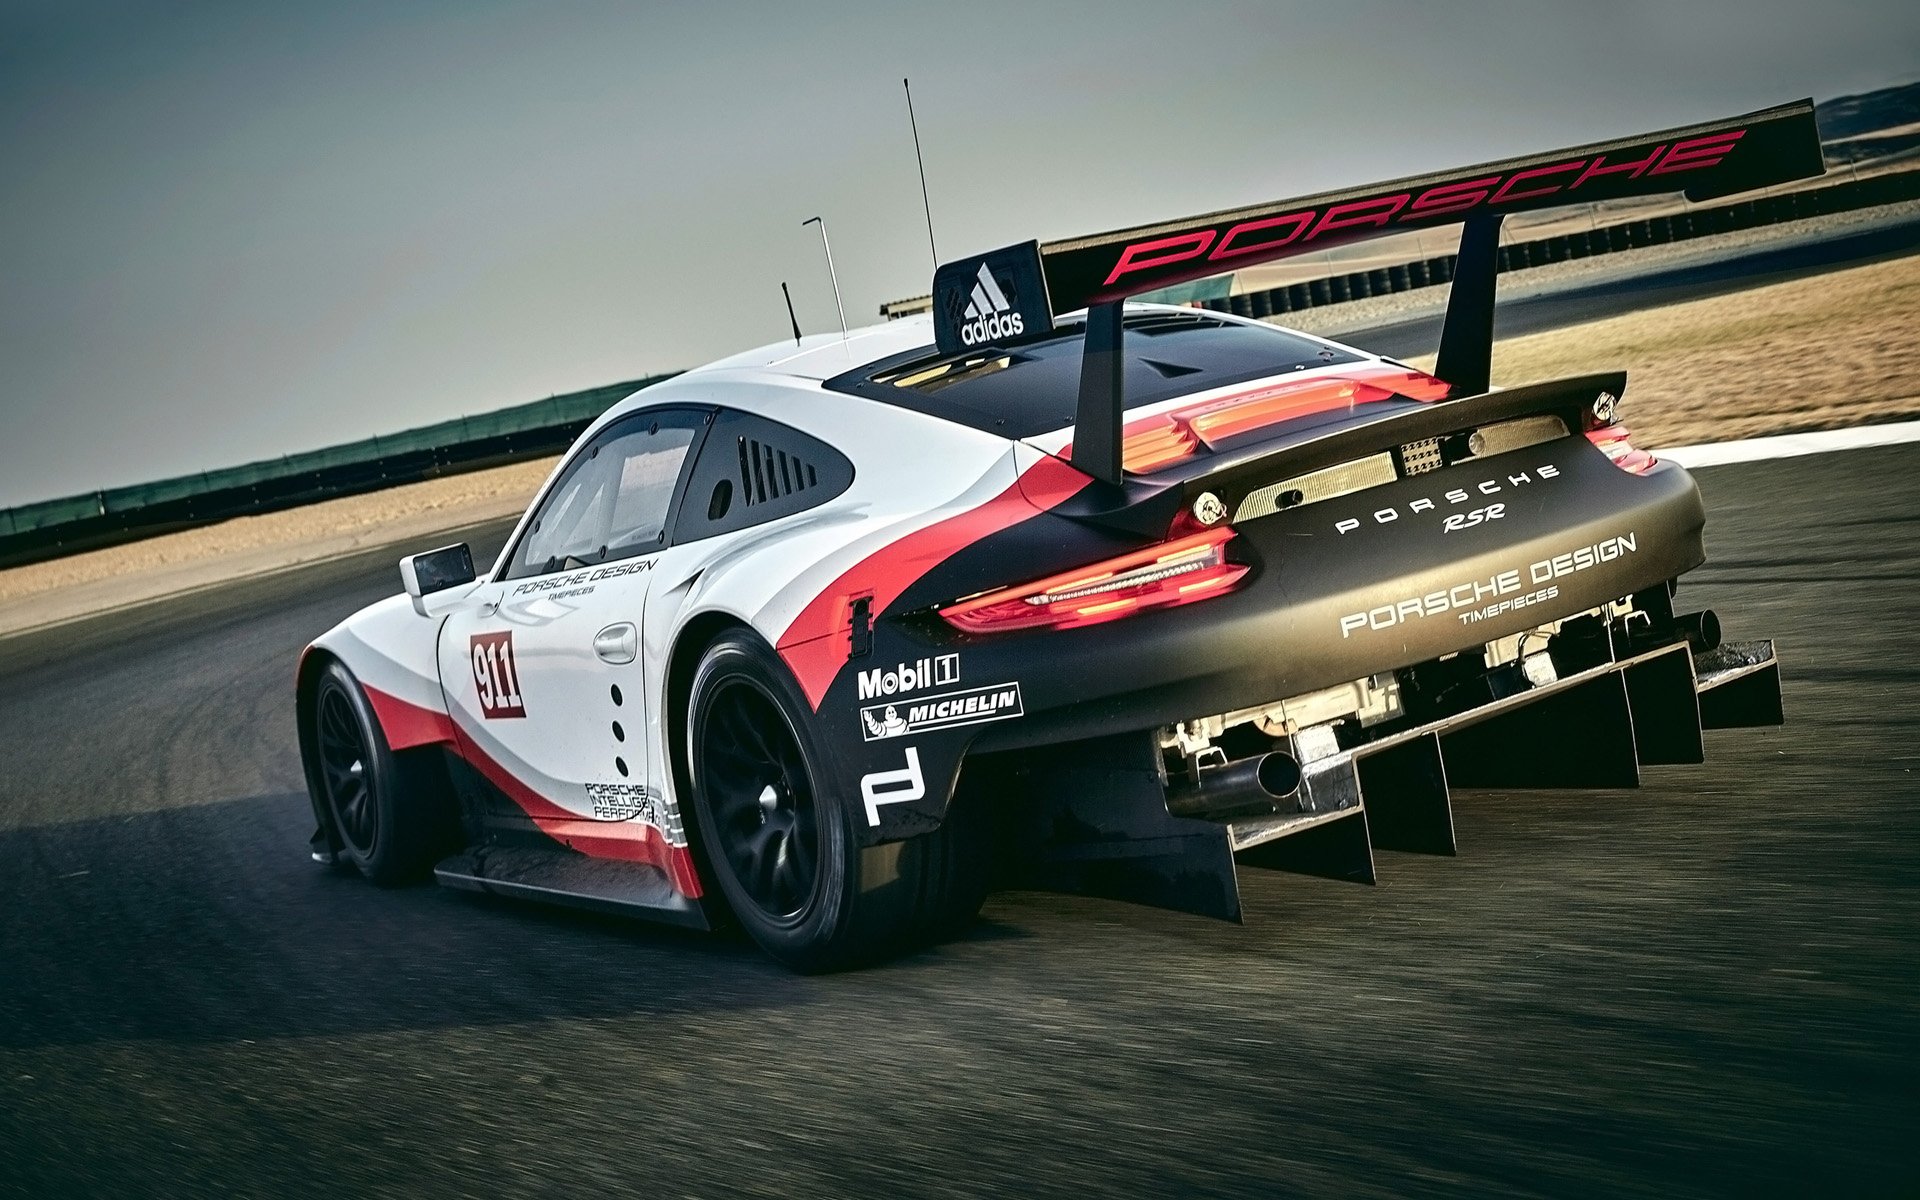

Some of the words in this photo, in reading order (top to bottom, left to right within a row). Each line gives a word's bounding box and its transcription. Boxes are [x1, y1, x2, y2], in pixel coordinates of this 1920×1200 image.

[1103, 130, 1747, 287] PORSCHE
[961, 311, 1024, 346] adidas
[1334, 464, 1561, 535] PORSCHE
[1442, 503, 1506, 534] RSR
[513, 571, 590, 597] PORSCHE
[589, 558, 660, 583] DESIGN
[548, 586, 596, 601] TIMEPIECES
[1340, 569, 1522, 639] PORSCHE
[1530, 532, 1638, 585] DESIGN
[1458, 585, 1559, 626] TIMEPIECES
[473, 640, 522, 710] 911
[857, 658, 931, 701] Mobil
[908, 690, 1016, 723] MICHELIN
[585, 783, 646, 796] PORSCHE
